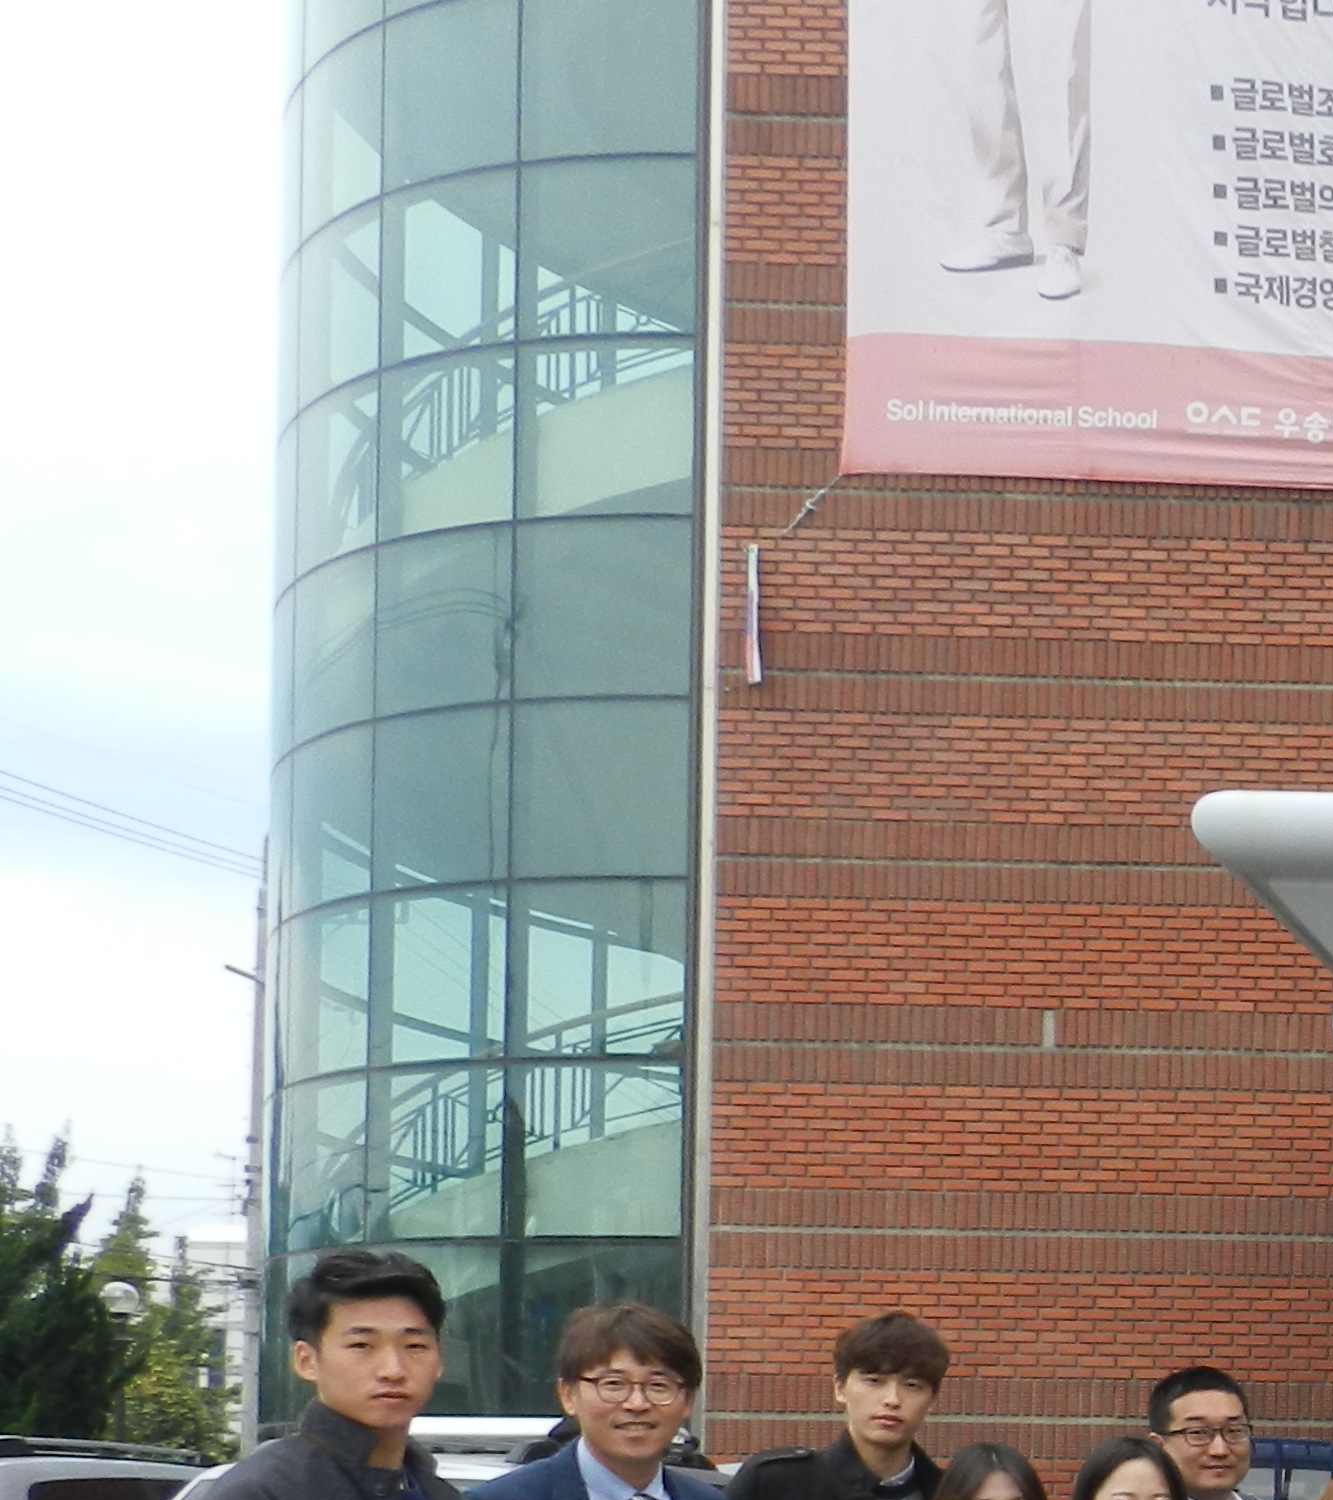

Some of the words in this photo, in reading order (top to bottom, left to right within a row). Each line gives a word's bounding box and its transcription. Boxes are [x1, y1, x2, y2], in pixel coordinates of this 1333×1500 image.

[886, 399, 924, 422] Sol
[929, 401, 1072, 426] International
[1078, 406, 1158, 429] School
